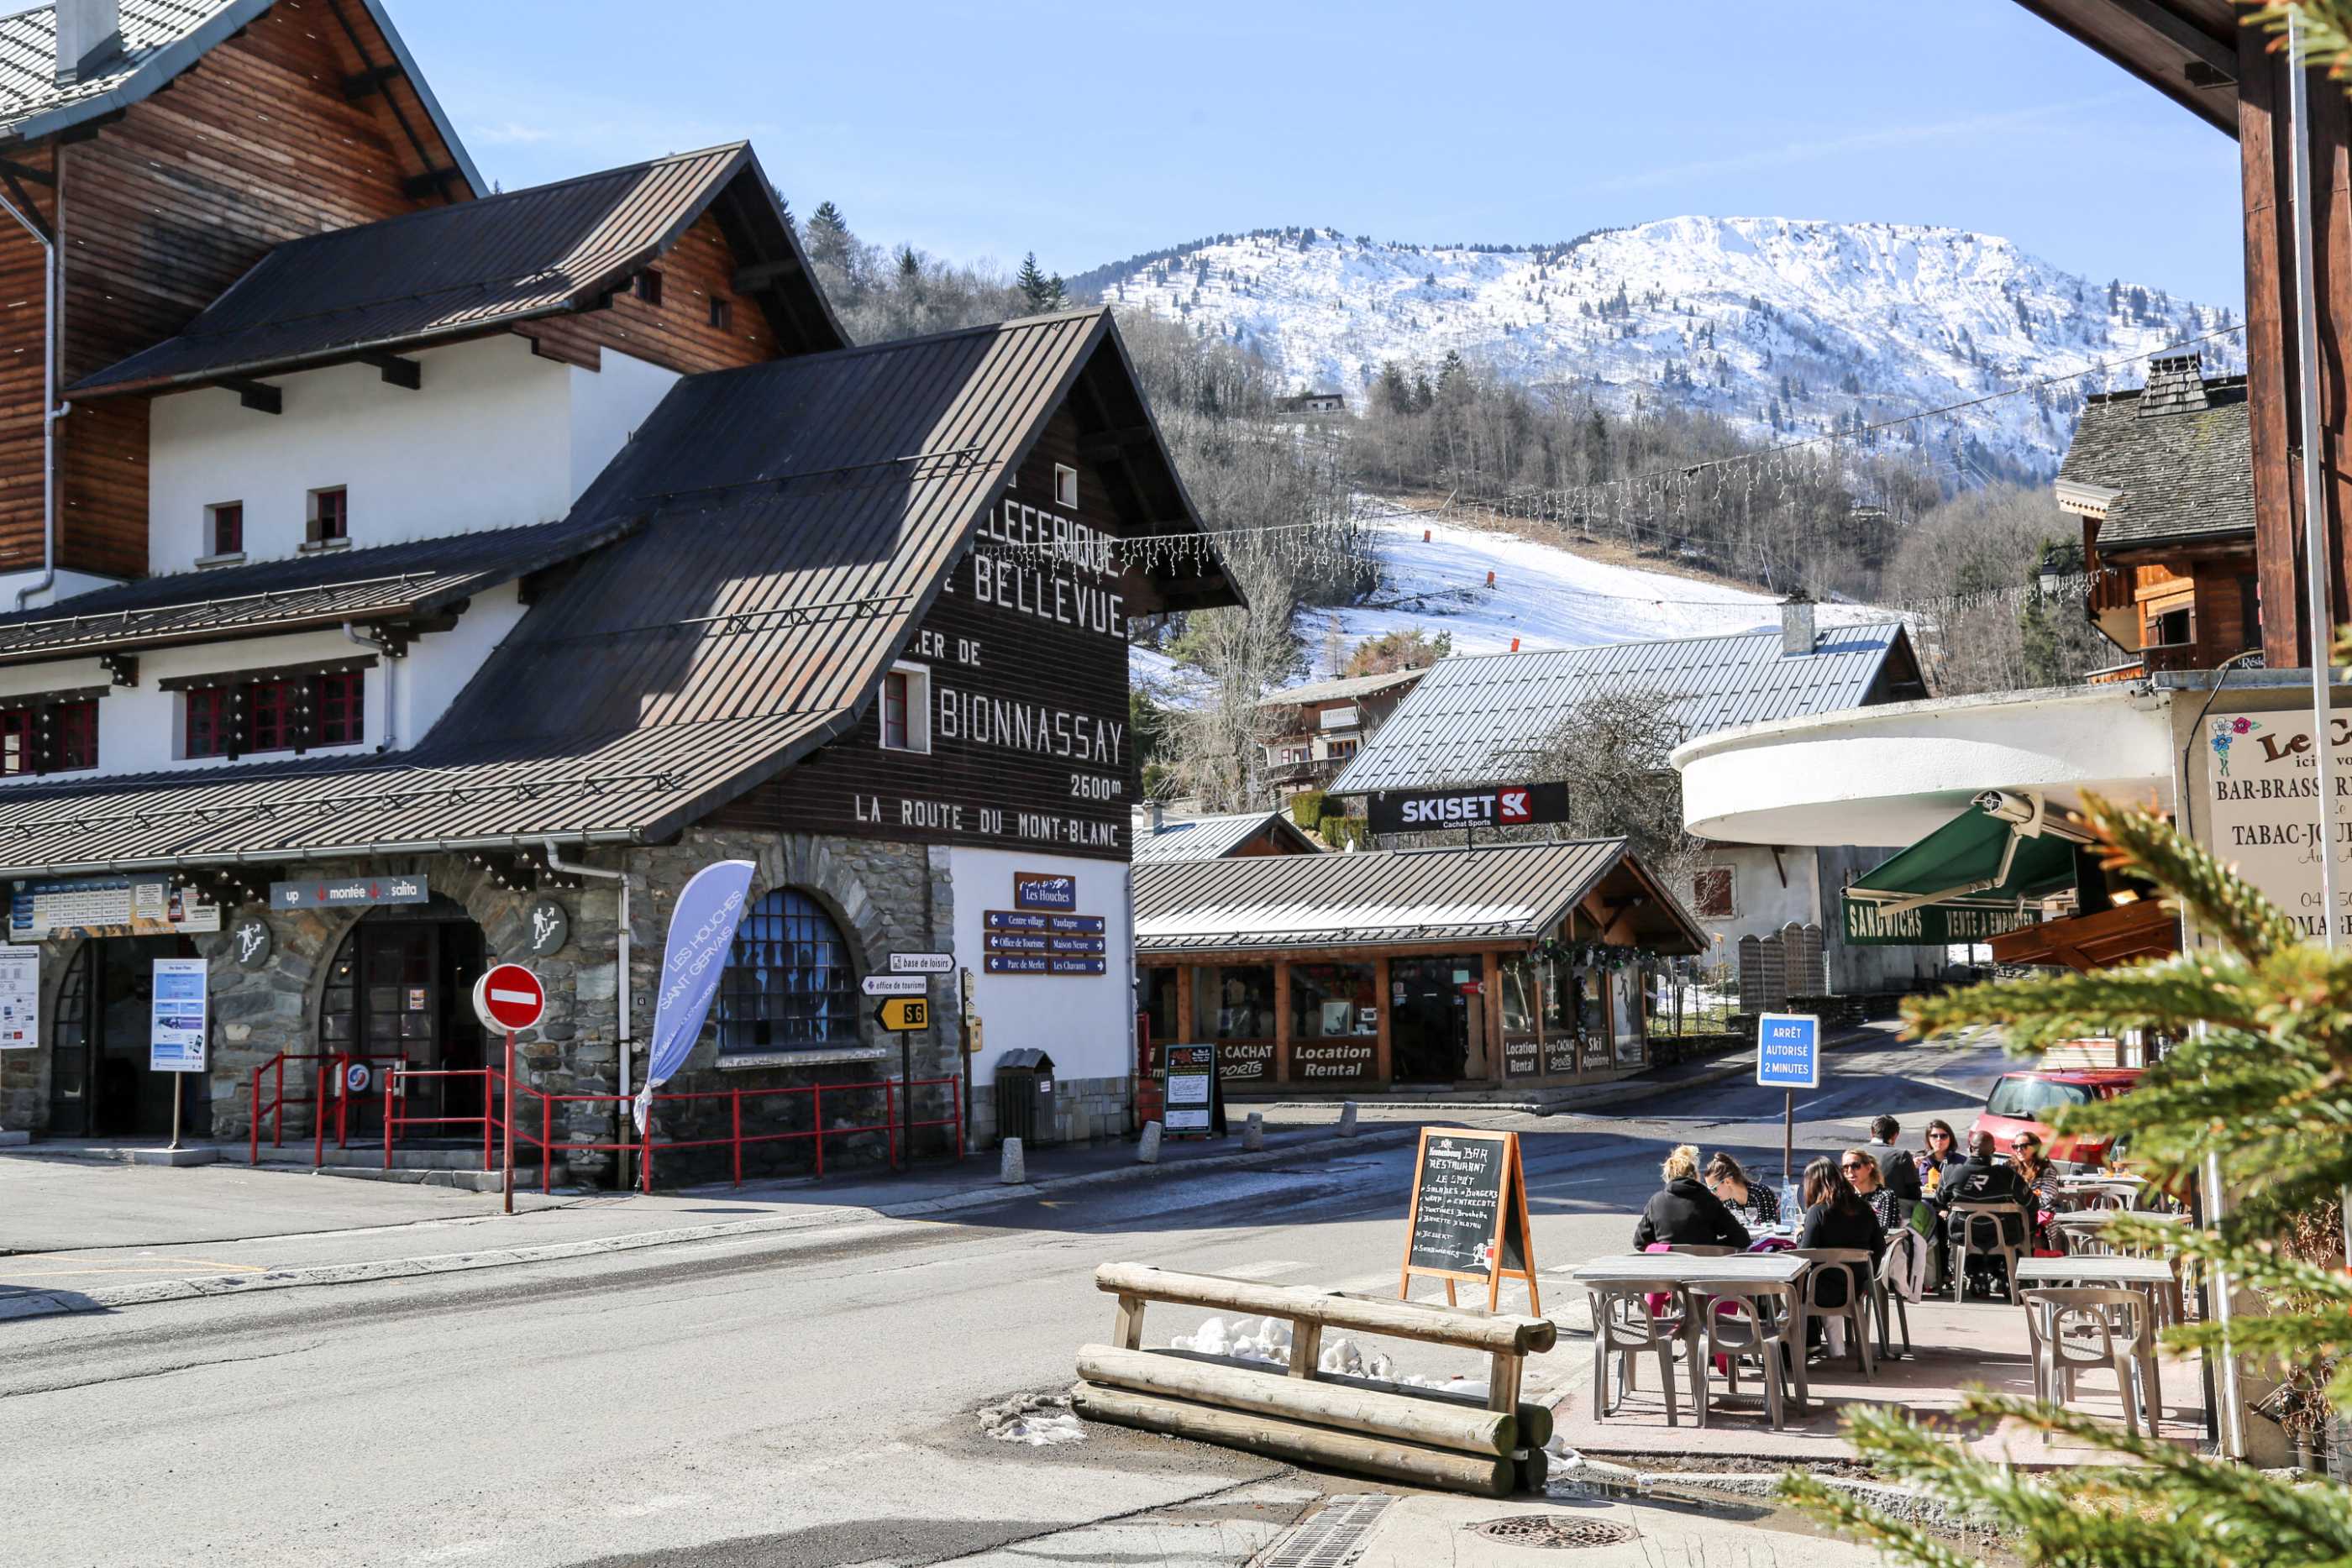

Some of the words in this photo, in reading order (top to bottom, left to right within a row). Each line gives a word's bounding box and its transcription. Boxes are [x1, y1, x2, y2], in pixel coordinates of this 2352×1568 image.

[975, 554, 1124, 637] BELLEVUE
[958, 638, 981, 666] DE
[940, 688, 1122, 765] BIONNASSAY
[2256, 733, 2311, 763] Le
[1070, 774, 1121, 800] 2600m
[1402, 795, 1496, 822] SKISET
[855, 794, 882, 823] LA
[901, 800, 963, 831] ROUTE
[980, 808, 1002, 834] DU
[1018, 813, 1119, 847] MONT-BLANC
[1468, 820, 1491, 828] Sports
[286, 890, 299, 904] up
[329, 884, 366, 899] montée
[391, 879, 417, 896] salita
[1026, 889, 1038, 901] Les
[1039, 889, 1069, 903] Houches
[2300, 892, 2321, 907] 04
[1008, 915, 1027, 926] Centre
[1027, 916, 1045, 927] village
[1053, 918, 1078, 930] Vaudagne
[1946, 910, 1977, 937] VENTE
[1981, 912, 1987, 937] A
[669, 947, 692, 973] LES
[690, 890, 743, 949] HOUCHES
[1000, 937, 1015, 947] Office
[1015, 938, 1022, 947] de
[1022, 939, 1045, 948] Tourisme
[1053, 940, 1072, 949] Maison
[1073, 941, 1089, 950] Neuve
[659, 974, 690, 1010] SAINT
[690, 926, 732, 976] GERVAIS
[903, 958, 918, 968] base
[920, 958, 928, 968] de
[929, 958, 948, 968] loisirs
[1007, 960, 1020, 969] Parc
[1020, 960, 1027, 969] de
[1027, 961, 1045, 970] Merlet
[1053, 961, 1063, 970] Les
[876, 981, 892, 989] office
[893, 981, 901, 989] de
[906, 1006, 913, 1022] S
[915, 1006, 922, 1022] 6
[1773, 1026, 1802, 1039] ARRÊT
[1505, 1041, 1538, 1056] Location
[1588, 1037, 1602, 1051] Ski
[1766, 1044, 1809, 1057] AUTORISÉ
[1225, 1045, 1273, 1058] CACHAT
[1295, 1045, 1372, 1059] Location
[1305, 1062, 1362, 1077] Rental
[1510, 1059, 1534, 1073] Rental
[1583, 1055, 1609, 1070] Alpinisme
[1764, 1062, 1771, 1072] 2
[1772, 1062, 1809, 1074] MINUTES
[1462, 1147, 1488, 1162] BAR
[1429, 1158, 1486, 1174] RESTAURANT
[1436, 1174, 1448, 1183] LE
[1451, 1174, 1474, 1186] SPOT
[1464, 1187, 1498, 1198] BURGERS
